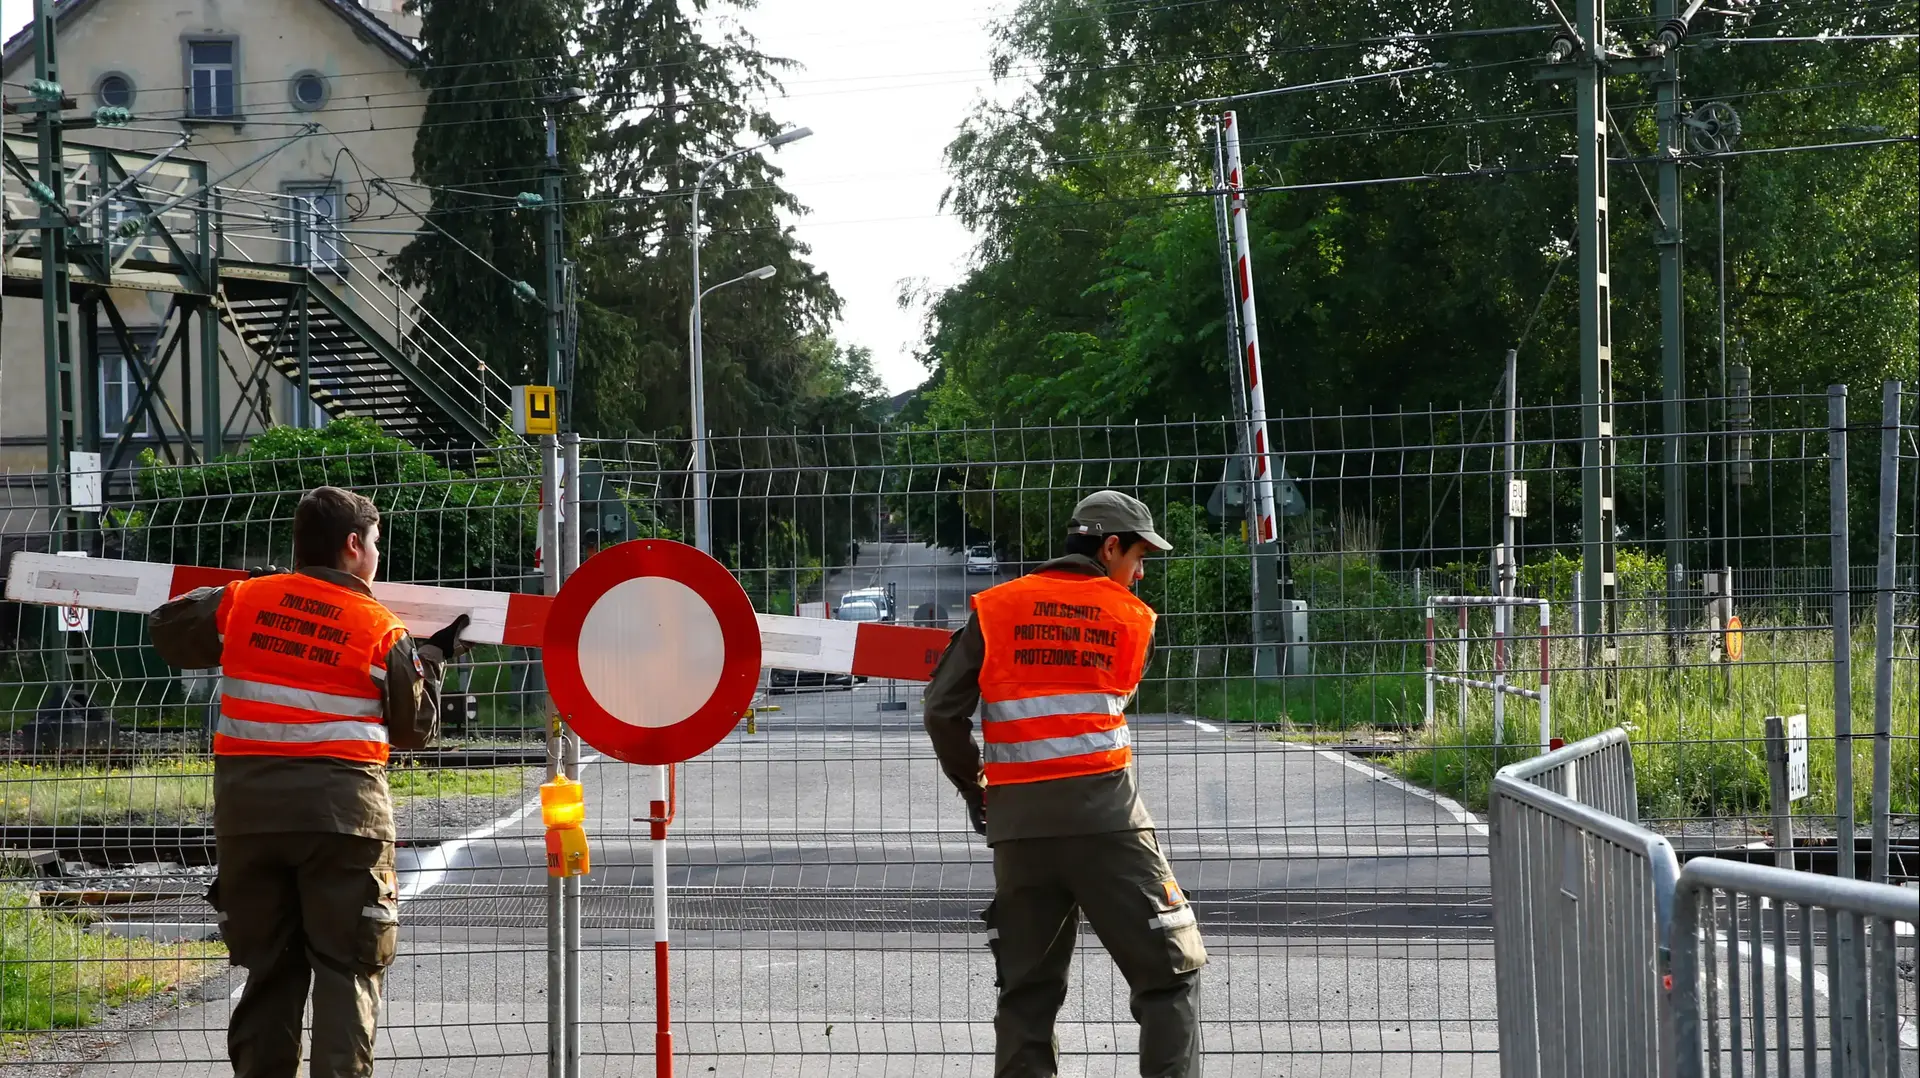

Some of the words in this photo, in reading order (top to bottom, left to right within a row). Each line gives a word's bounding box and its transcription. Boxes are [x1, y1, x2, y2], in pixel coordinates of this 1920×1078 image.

[279, 593, 344, 620] ZIVILSCHUTZ
[1033, 601, 1101, 621] ZIVILSCHUTZ
[255, 610, 318, 638] PROTECTION
[318, 625, 352, 646] CIVILE
[1014, 624, 1081, 642] PROTECTION
[1084, 628, 1118, 648] CIVILE
[249, 632, 309, 659] PROTEZIONE
[308, 645, 342, 666] CIVILE
[1014, 648, 1079, 666] PROTEZIONE
[1081, 650, 1114, 671] CIVILE
